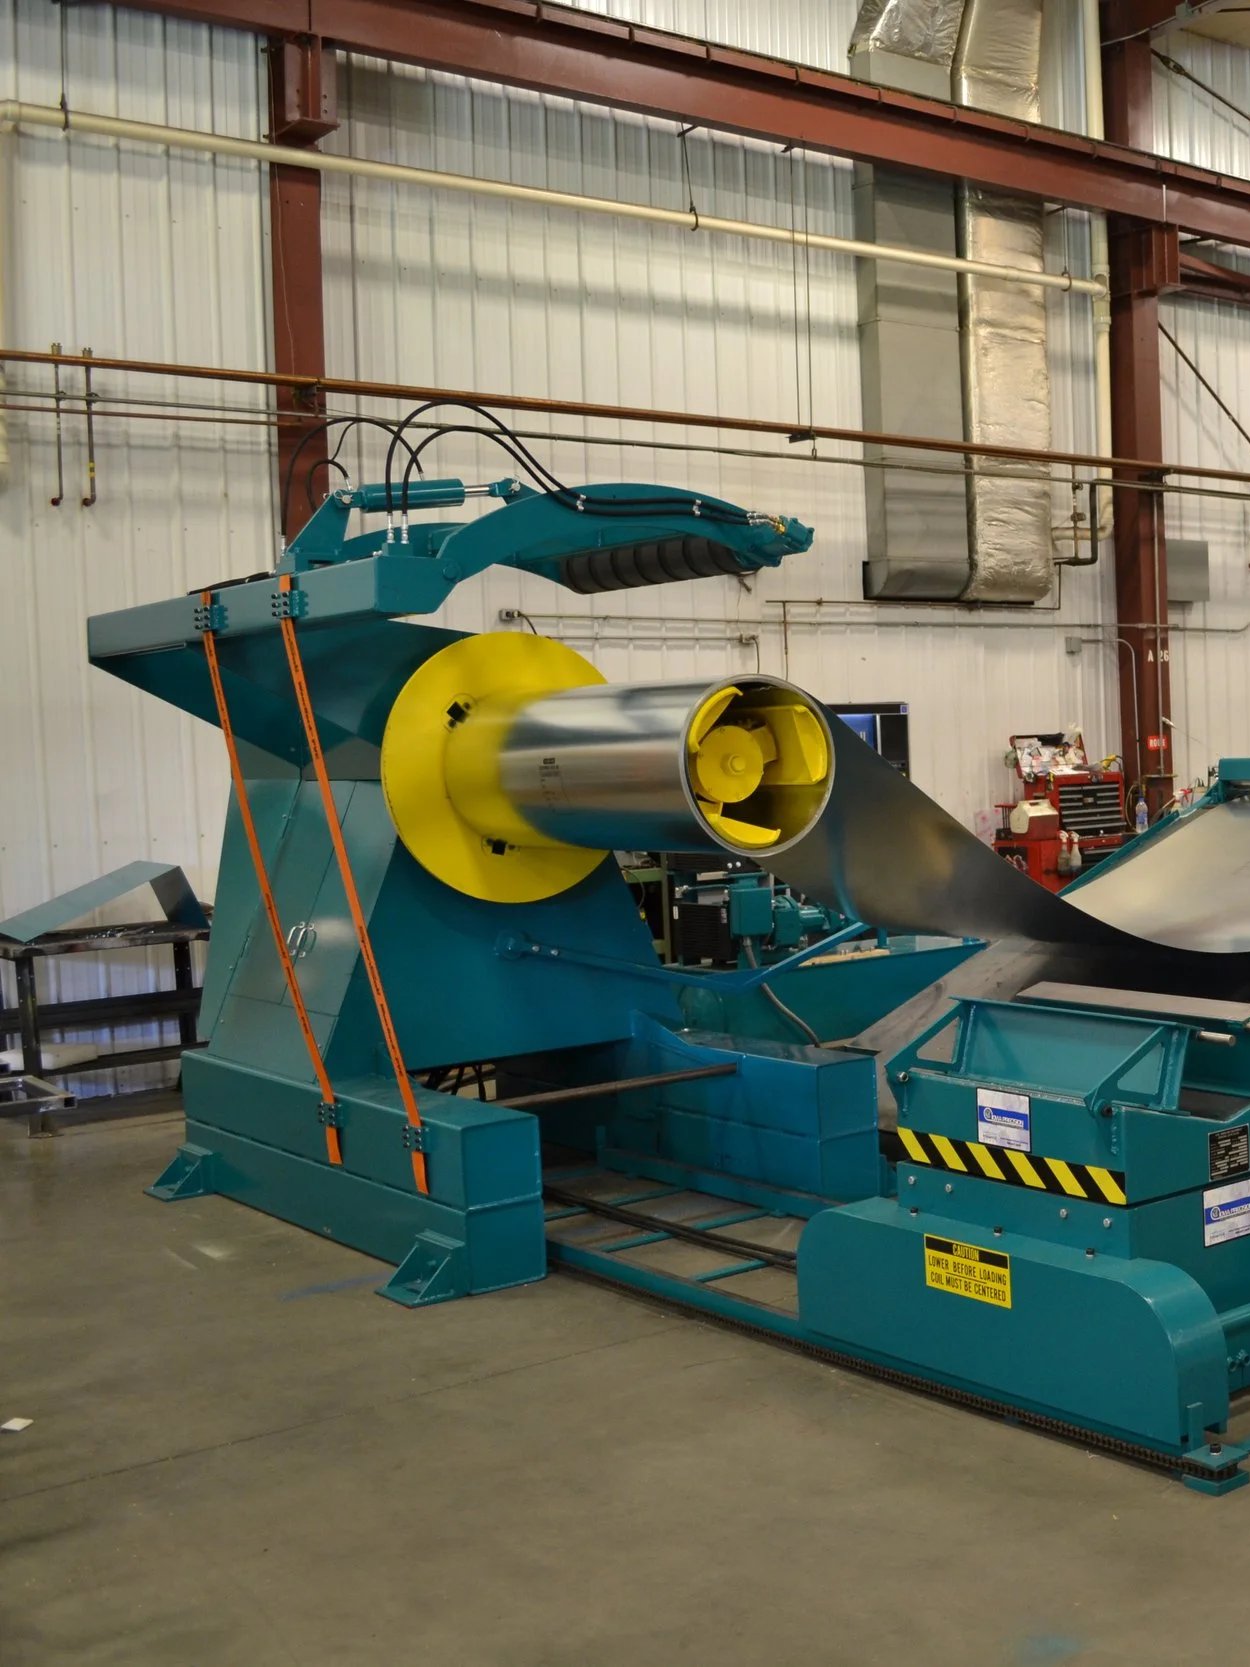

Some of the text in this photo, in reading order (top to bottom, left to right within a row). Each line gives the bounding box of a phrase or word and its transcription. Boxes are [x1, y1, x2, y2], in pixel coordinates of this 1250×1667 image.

[952, 1243, 980, 1262] CAUTION
[928, 1255, 1007, 1286] LOWER BEFORE LOADING
[930, 1271, 1006, 1302] COIL MUST BE CENTERED
